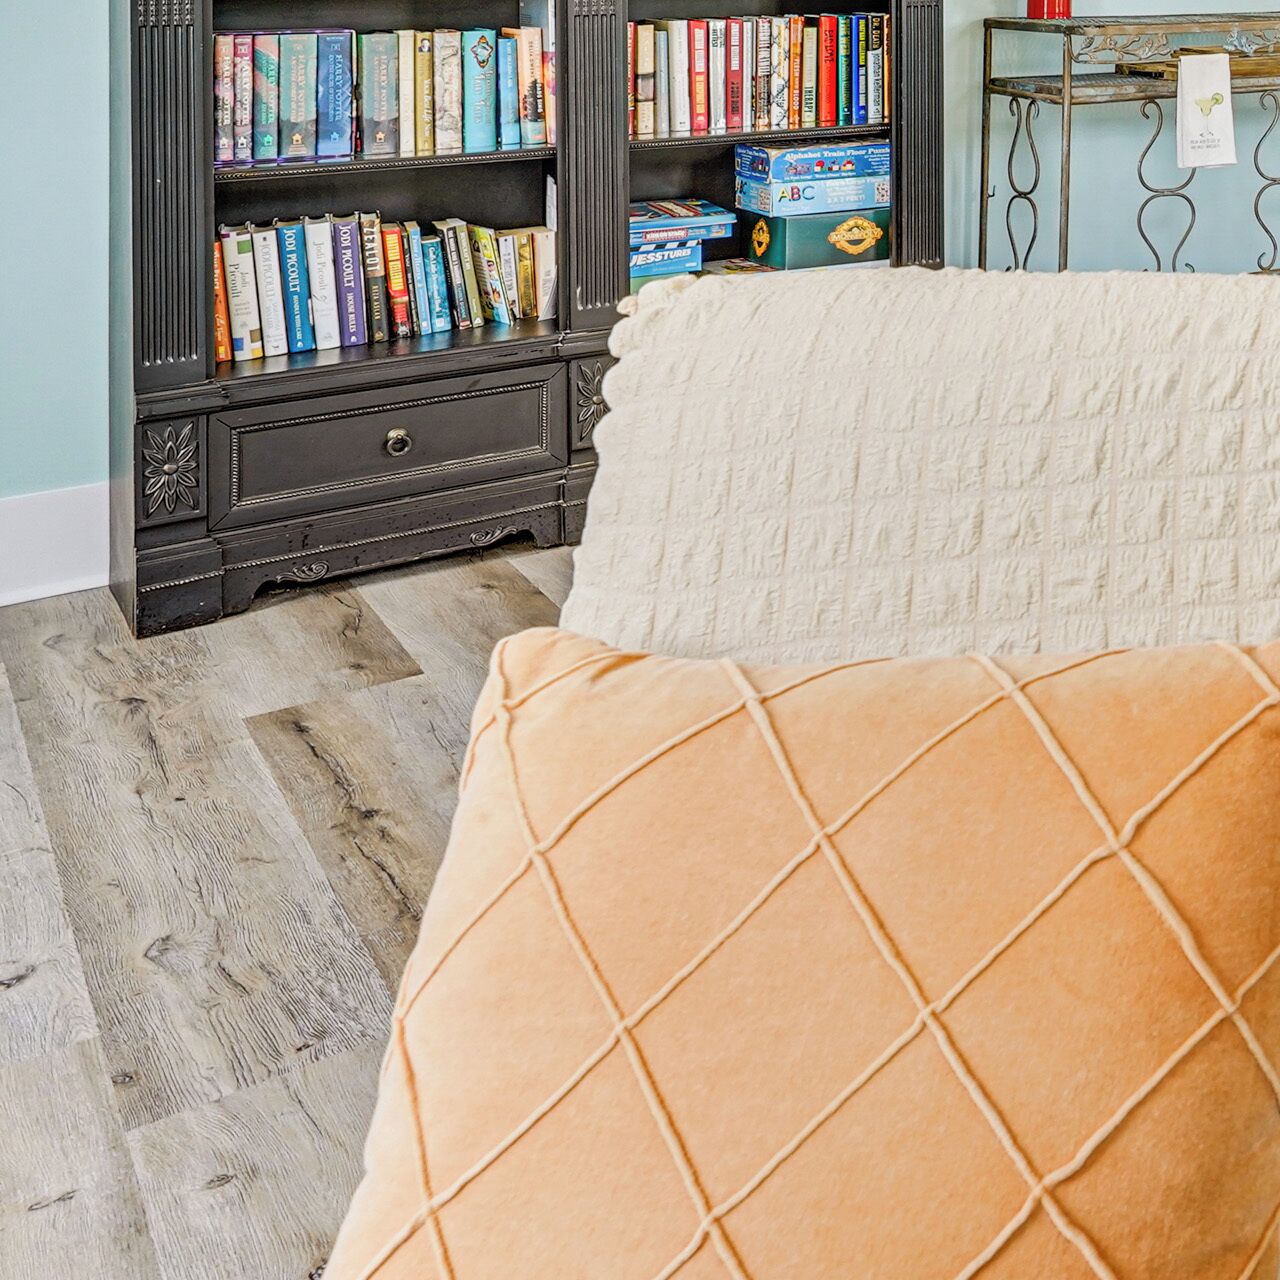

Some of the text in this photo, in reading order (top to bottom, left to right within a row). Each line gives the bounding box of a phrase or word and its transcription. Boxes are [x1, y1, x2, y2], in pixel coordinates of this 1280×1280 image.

[872, 18, 880, 29] DR.
[872, 53, 880, 77] jonathan
[222, 56, 232, 125] HARRY POTTER
[241, 56, 251, 125] HARRY POTTER
[268, 58, 276, 123] HARRY POTTER
[297, 54, 306, 122] HARRY POTTER
[334, 54, 344, 122] HARRY POTTER
[380, 55, 388, 121] HARRY POTTER
[804, 86, 814, 113] THERAPY
[873, 79, 881, 106] kellerman
[785, 151, 821, 161] Alphabet
[822, 149, 845, 158] Train
[846, 148, 867, 157] Floor
[778, 185, 815, 203] ABC
[260, 243, 271, 262] JODI
[284, 229, 297, 251] JODI
[228, 263, 242, 298] Picoult
[240, 271, 249, 288] Jodi
[263, 263, 275, 298] PICOULT
[286, 253, 300, 292] PICOULT
[313, 240, 328, 291] Jodi Picoult
[340, 224, 357, 332] JODI PICOULT HOUSE RULES
[363, 226, 380, 272] ZEALOT
[372, 301, 381, 320] ASLAN
[430, 260, 438, 274] Little
